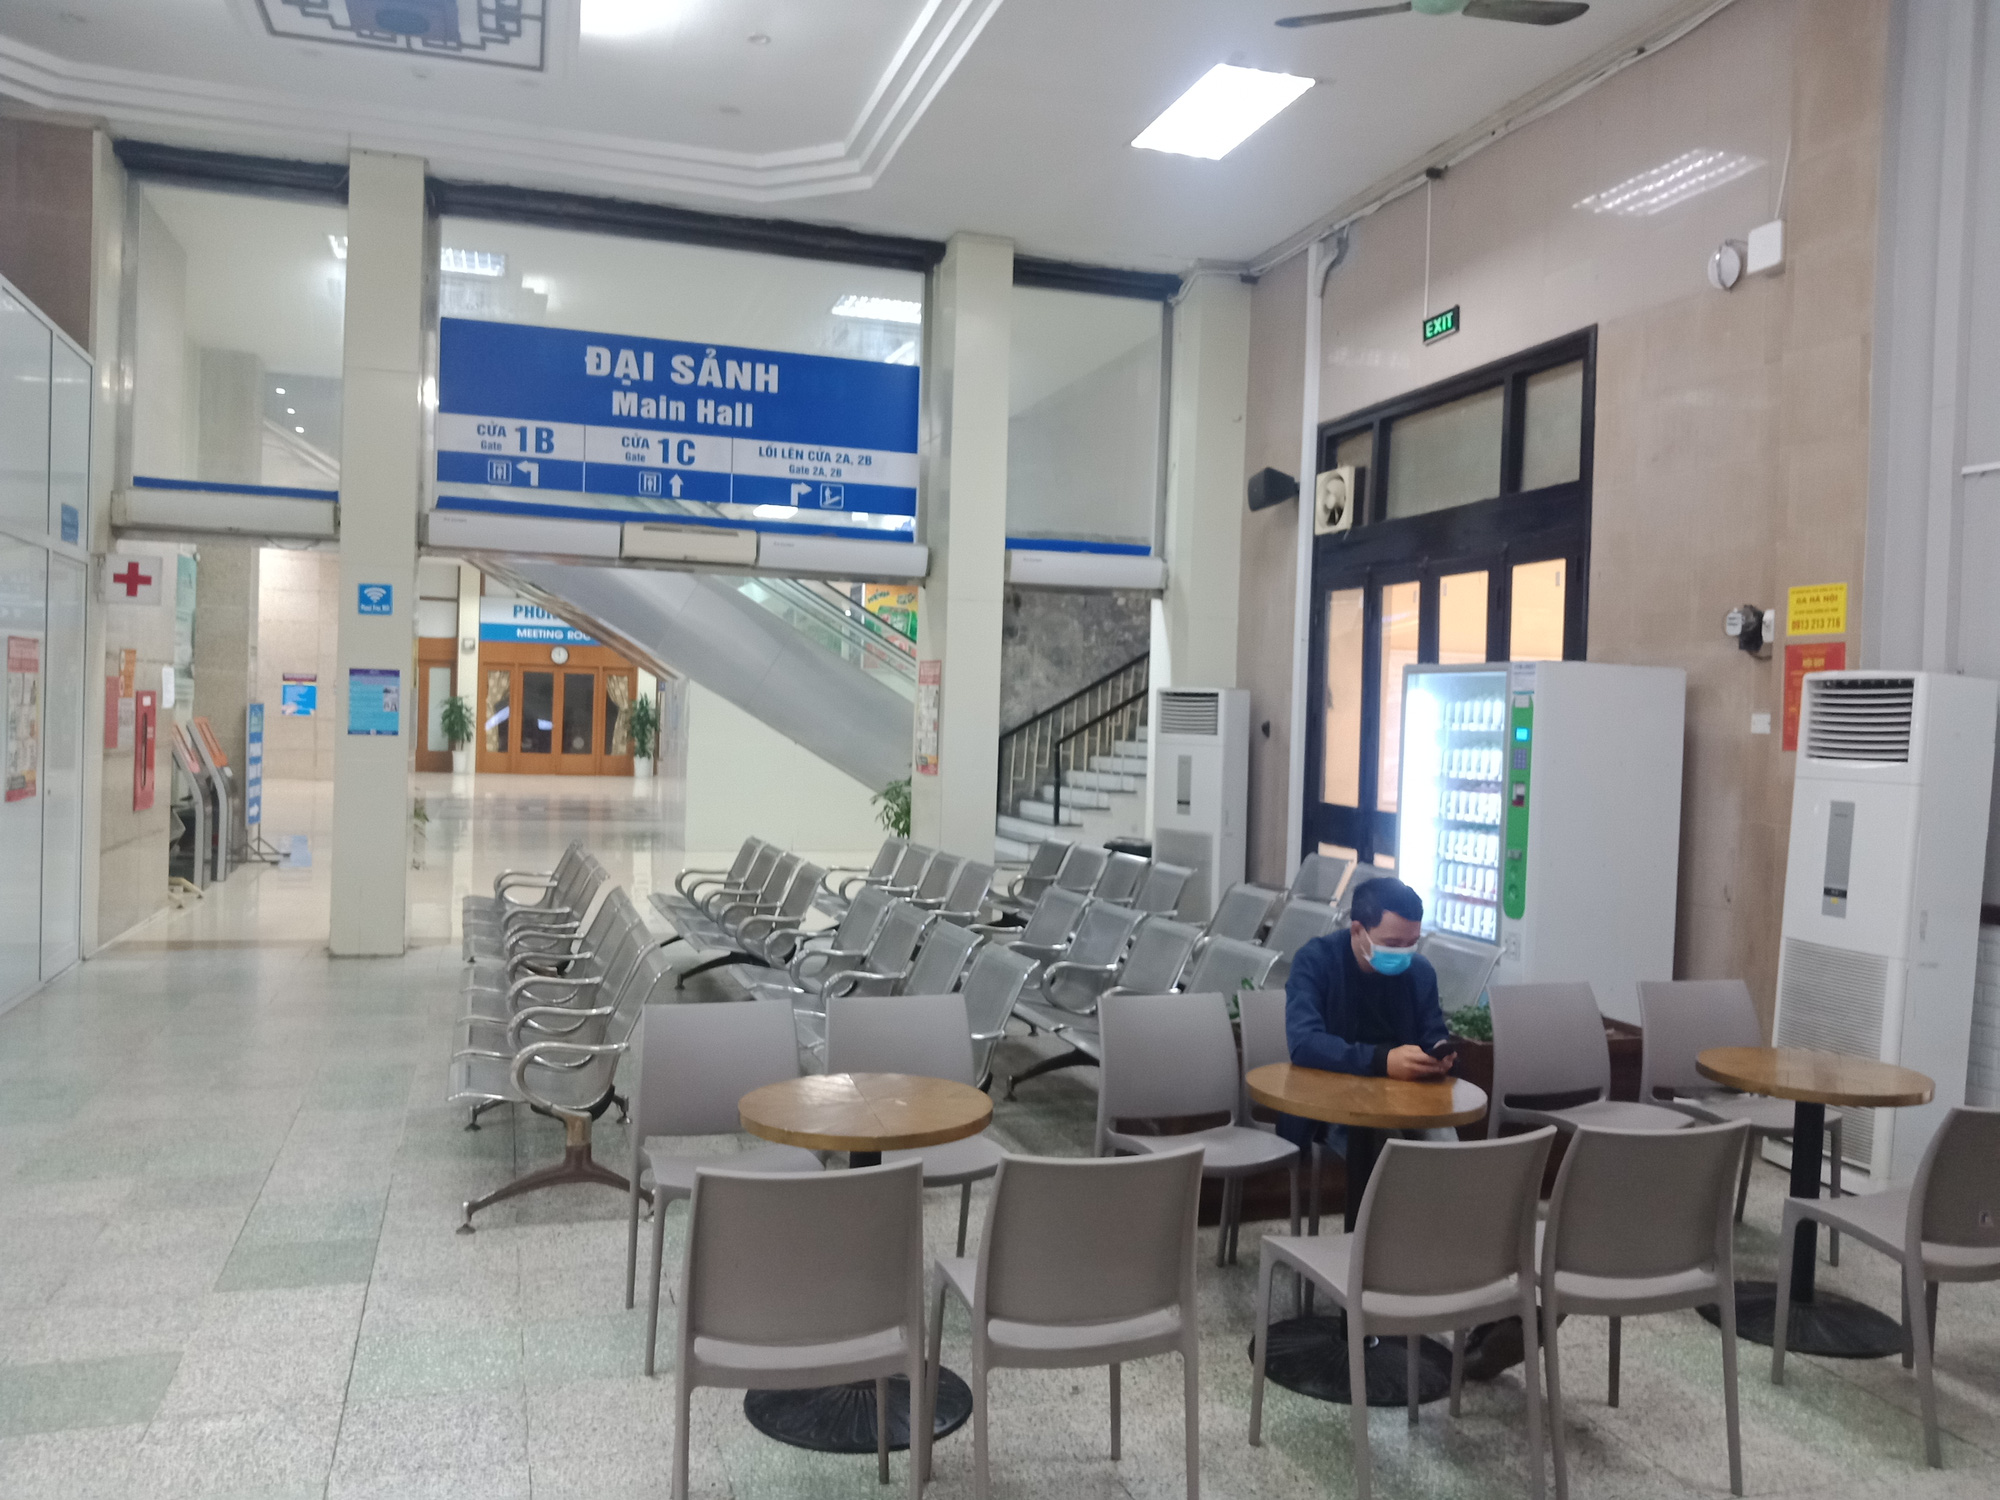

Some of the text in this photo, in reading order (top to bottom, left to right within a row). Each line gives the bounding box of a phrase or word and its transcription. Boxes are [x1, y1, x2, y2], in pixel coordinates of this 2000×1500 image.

[1425, 311, 1454, 338] EXIT
[584, 345, 779, 394] ĐẠI SẢNH
[612, 390, 753, 428] Main Hall
[476, 420, 554, 453] CỬA 1B
[480, 439, 502, 451] Gate
[621, 432, 696, 466] CỬA 1C
[625, 451, 646, 463] Gate
[788, 463, 810, 475] Gate
[830, 467, 843, 478] 2B
[857, 454, 873, 466] 2B
[516, 627, 591, 641] MEETING ROO
